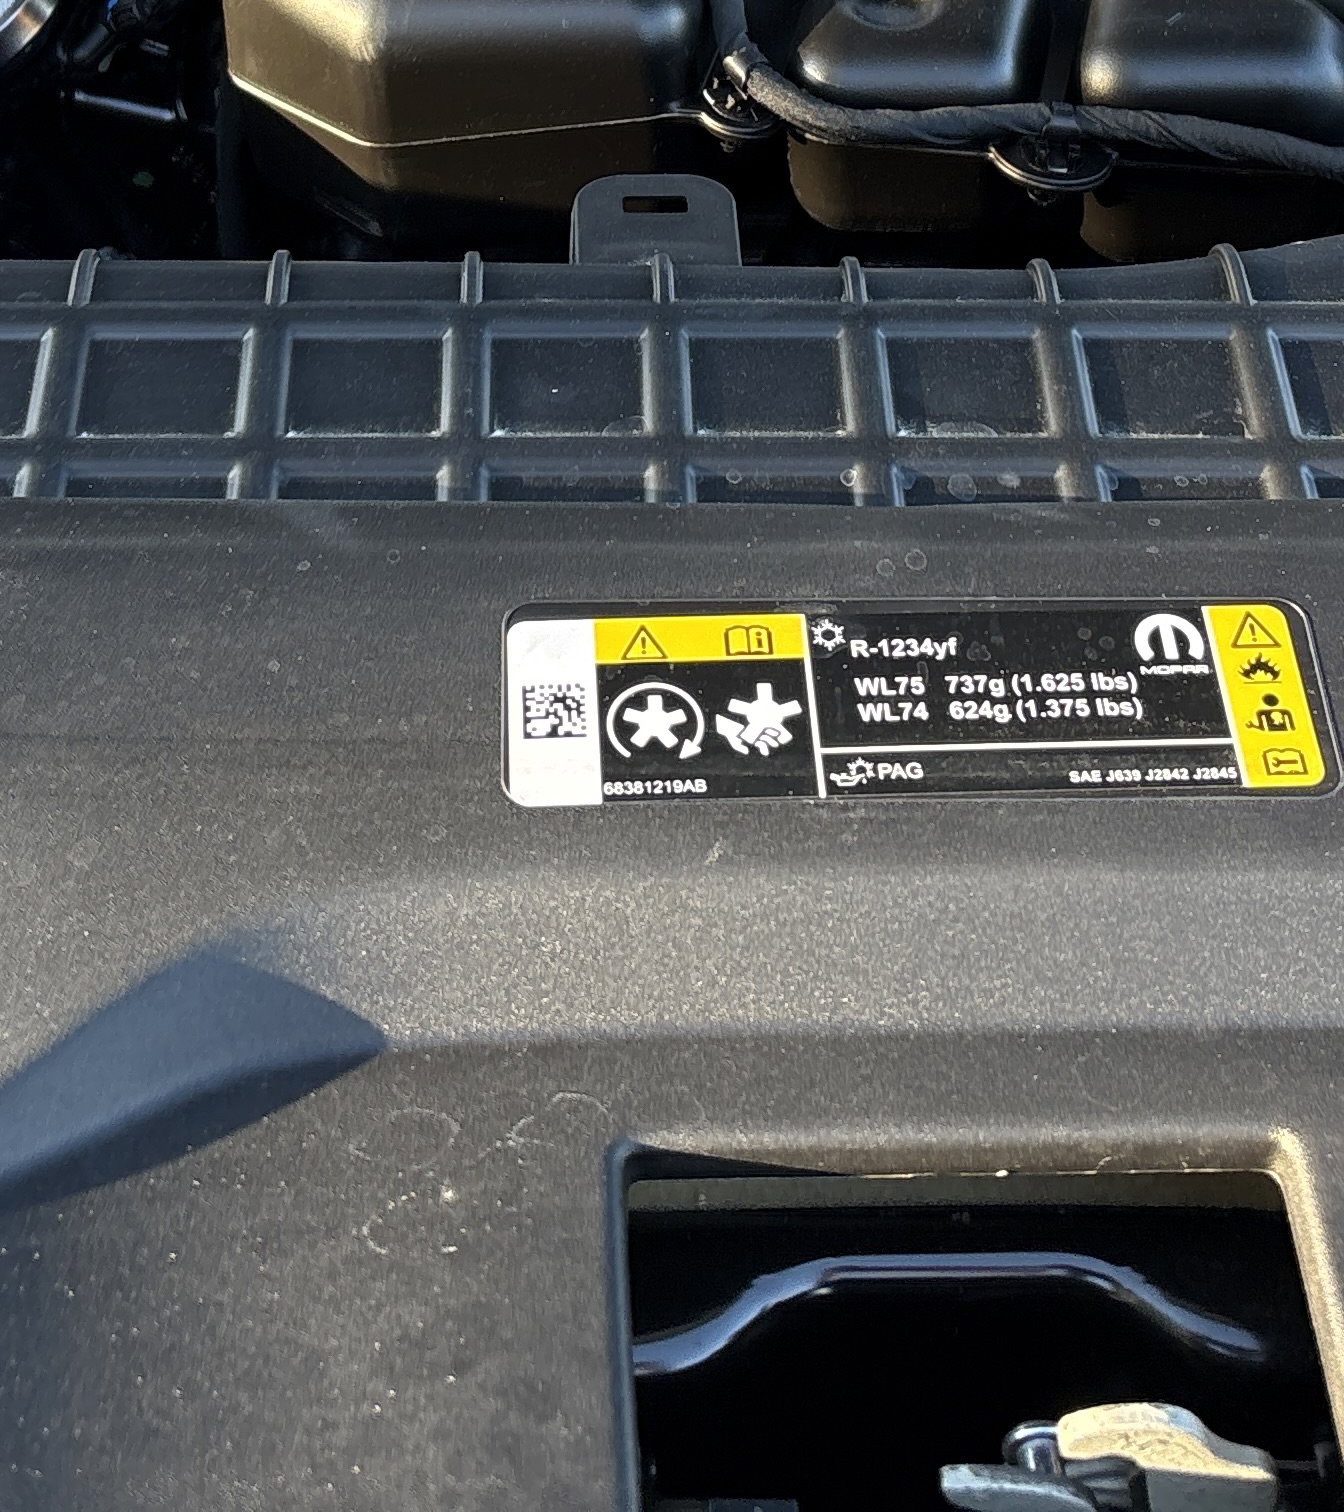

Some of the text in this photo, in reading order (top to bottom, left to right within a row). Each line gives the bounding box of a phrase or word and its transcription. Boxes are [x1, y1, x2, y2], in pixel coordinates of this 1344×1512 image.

[849, 636, 958, 661] R-1234yf
[1139, 664, 1210, 676] MOPAR
[853, 671, 1138, 698] WL75 737g (1.625 lbs)
[856, 696, 1144, 724] WL74 624g (1.375 lbs)
[877, 761, 924, 780] PAG
[1068, 769, 1103, 784] SAE
[1144, 767, 1190, 782] J2842
[1193, 766, 1238, 781] J2845
[603, 778, 708, 796] 68381219AB
